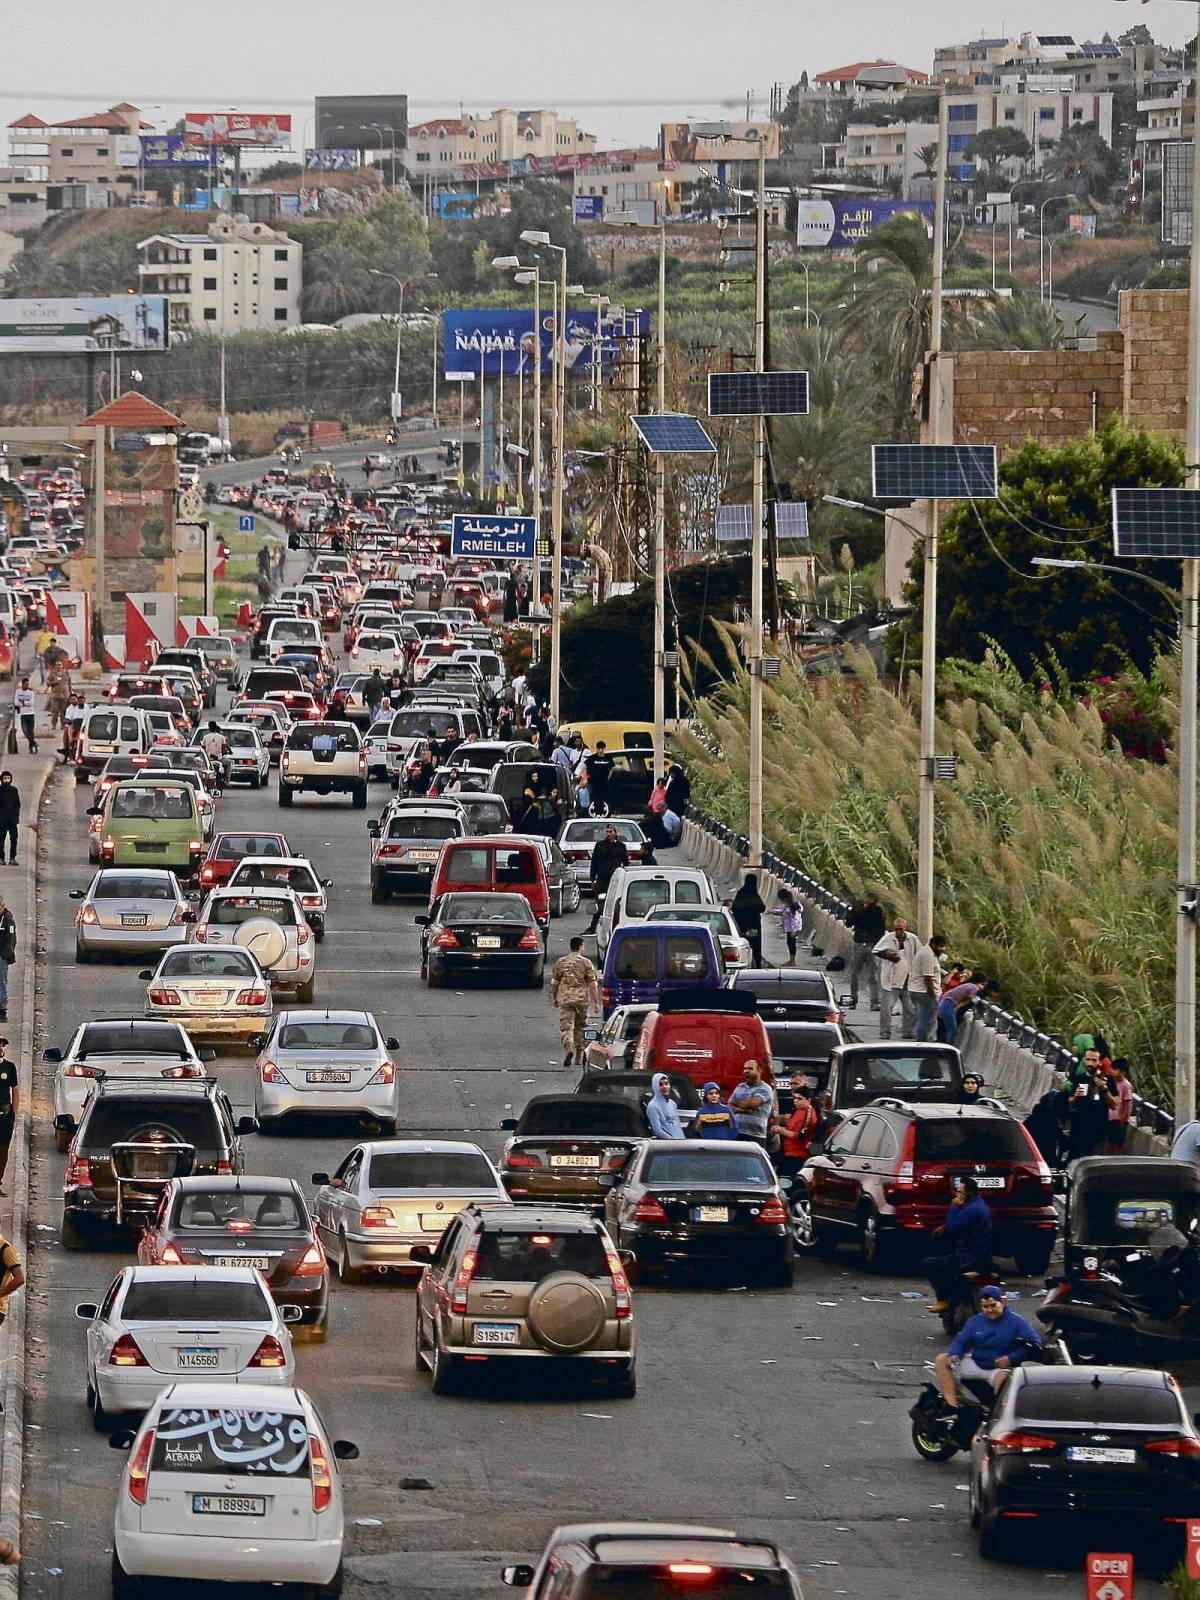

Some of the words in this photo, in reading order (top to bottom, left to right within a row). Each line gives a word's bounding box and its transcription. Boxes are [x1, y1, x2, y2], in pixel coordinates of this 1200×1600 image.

[454, 334, 516, 354] NAJJAR
[462, 519, 525, 537] الرميلة
[461, 540, 526, 552] RMEILEH
[477, 1331, 515, 1342] S195147
[179, 1355, 218, 1366] N145560
[165, 1453, 203, 1462] ALBABA
[202, 1500, 211, 1508] M
[218, 1500, 257, 1511] 188994
[1092, 1559, 1128, 1574] OPEN
